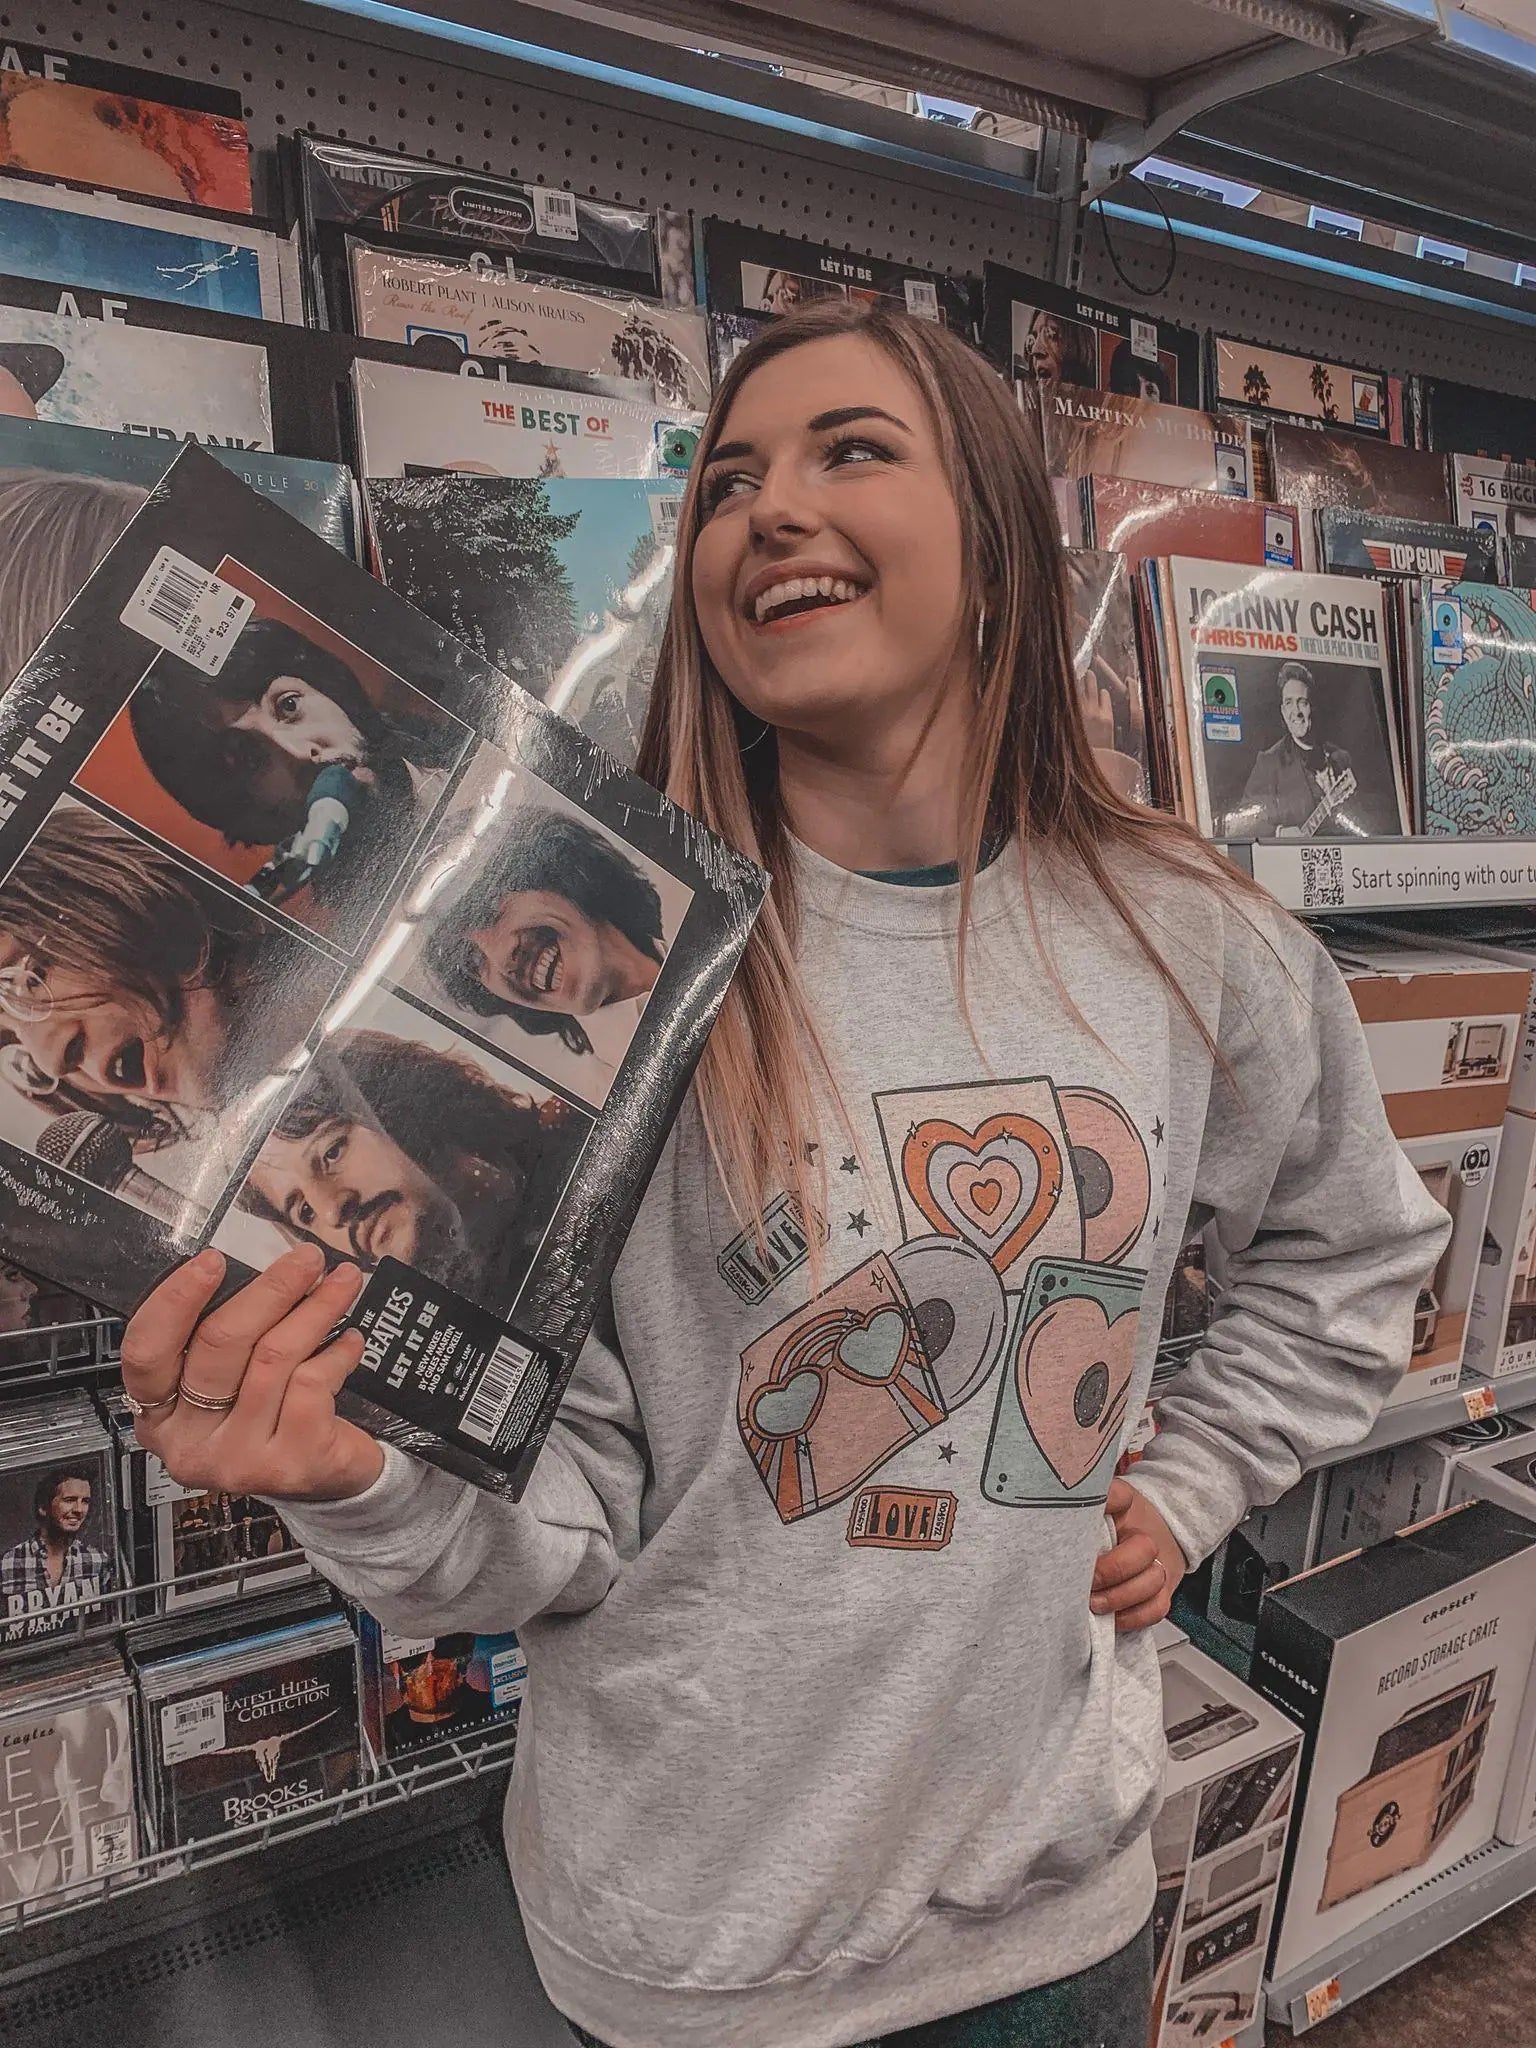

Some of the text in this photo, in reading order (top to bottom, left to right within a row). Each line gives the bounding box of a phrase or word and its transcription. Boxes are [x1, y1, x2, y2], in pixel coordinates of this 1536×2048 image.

[462, 201, 491, 213] LIMITED
[820, 257, 872, 282] LET IT BE
[382, 275, 432, 297] ROBERT
[437, 286, 477, 304] PLANT
[492, 297, 536, 314] ALISON
[538, 306, 585, 324] KRAUSS
[1076, 303, 1119, 328] LET IT BE
[482, 401, 610, 435] THE BEST OF
[1054, 396, 1147, 430] MARTINA
[243, 472, 289, 489] DELE
[1480, 480, 1496, 497] 16
[1389, 543, 1446, 576] TOP GUN
[208, 582, 221, 596] NR
[215, 606, 238, 638] $23.97
[1189, 587, 1378, 644] JOHNNY CASH
[1190, 627, 1298, 652] CHRISTMAS
[10, 736, 52, 778] IT
[35, 692, 85, 744] BE
[1352, 867, 1393, 890] Start
[1397, 866, 1461, 893] spinning
[1464, 864, 1496, 886] with
[1500, 869, 1524, 884] our
[360, 1309, 376, 1329] THE
[386, 1300, 440, 1389] LET IT BE
[415, 1329, 443, 1377] NEW MIXES
[418, 1324, 456, 1391] BY GILES MARTIN
[1500, 1350, 1536, 1367] JOUR
[427, 1373, 442, 1395] AND
[437, 1352, 451, 1375] SAM
[446, 1331, 463, 1355] OKELL
[458, 1352, 486, 1402] thebeatles.com
[869, 1494, 932, 1539] LOVE
[8, 1575, 102, 1632] BRYAN
[1422, 1590, 1479, 1625] CROSLEY
[5, 1617, 66, 1642] MY PARTY
[1260, 1650, 1319, 1696] CROSLEY
[1377, 1656, 1419, 1697] RECORD
[1420, 1637, 1466, 1672] STORAGE
[1467, 1616, 1500, 1648] CRATE
[225, 1689, 274, 1713] EATEST
[481, 1708, 517, 1724] SESSIO
